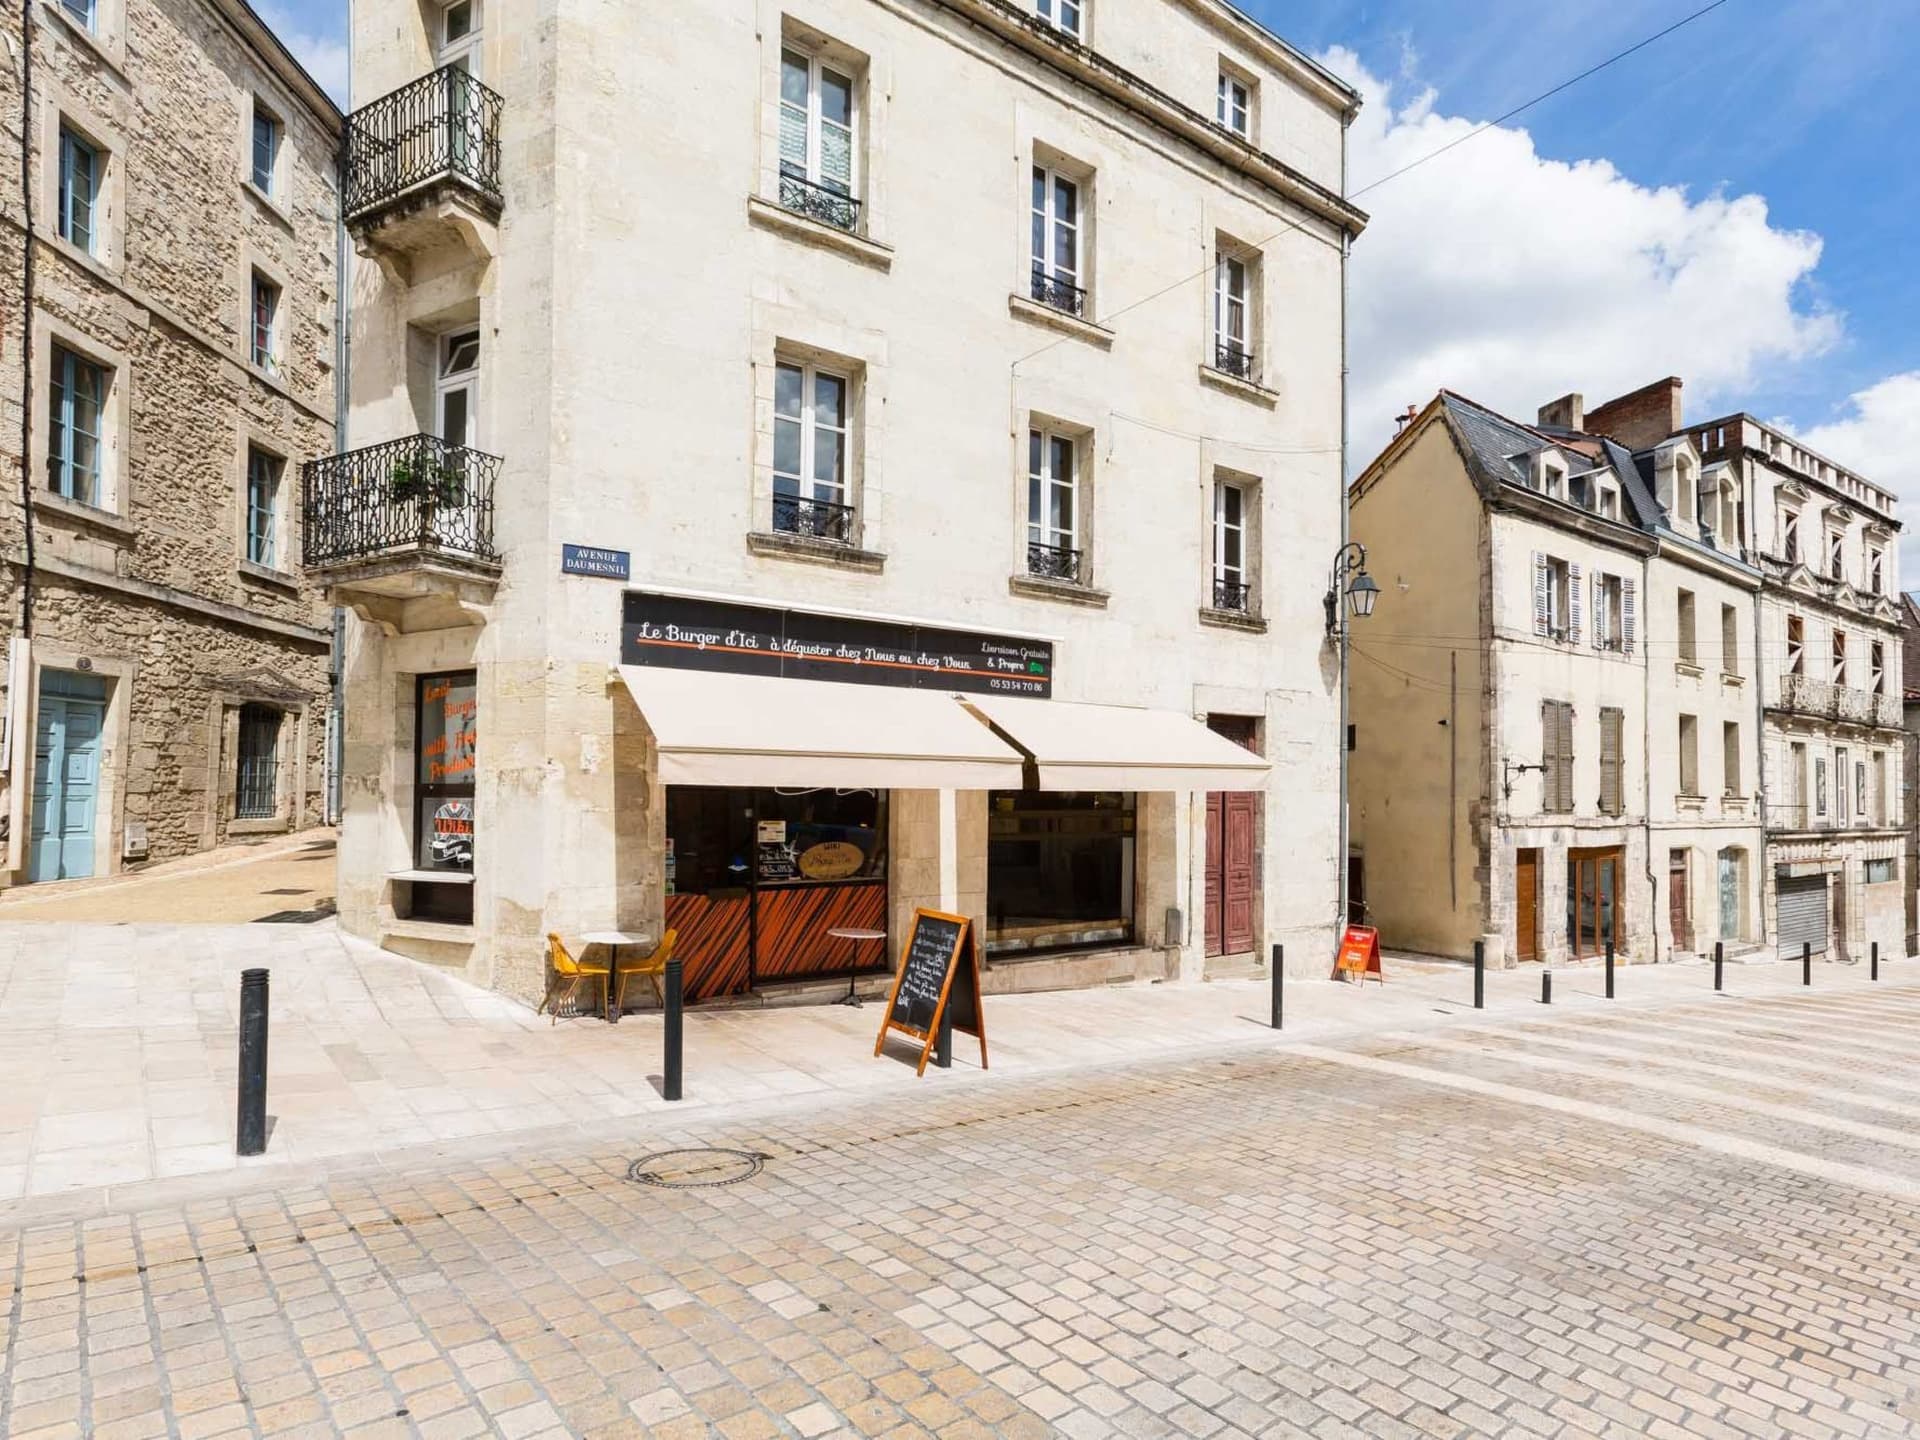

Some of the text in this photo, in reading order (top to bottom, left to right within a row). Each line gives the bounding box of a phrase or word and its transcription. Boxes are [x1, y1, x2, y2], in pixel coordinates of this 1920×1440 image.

[577, 548, 618, 563] AVENUE
[566, 558, 627, 575] DAUMESNIL
[639, 621, 972, 672] Le Burger d'Ici à déguster chez Nous ou chez Vous
[986, 656, 995, 668] &
[990, 678, 1000, 689] 05
[1001, 680, 1010, 690] 53
[1022, 682, 1032, 691] 70
